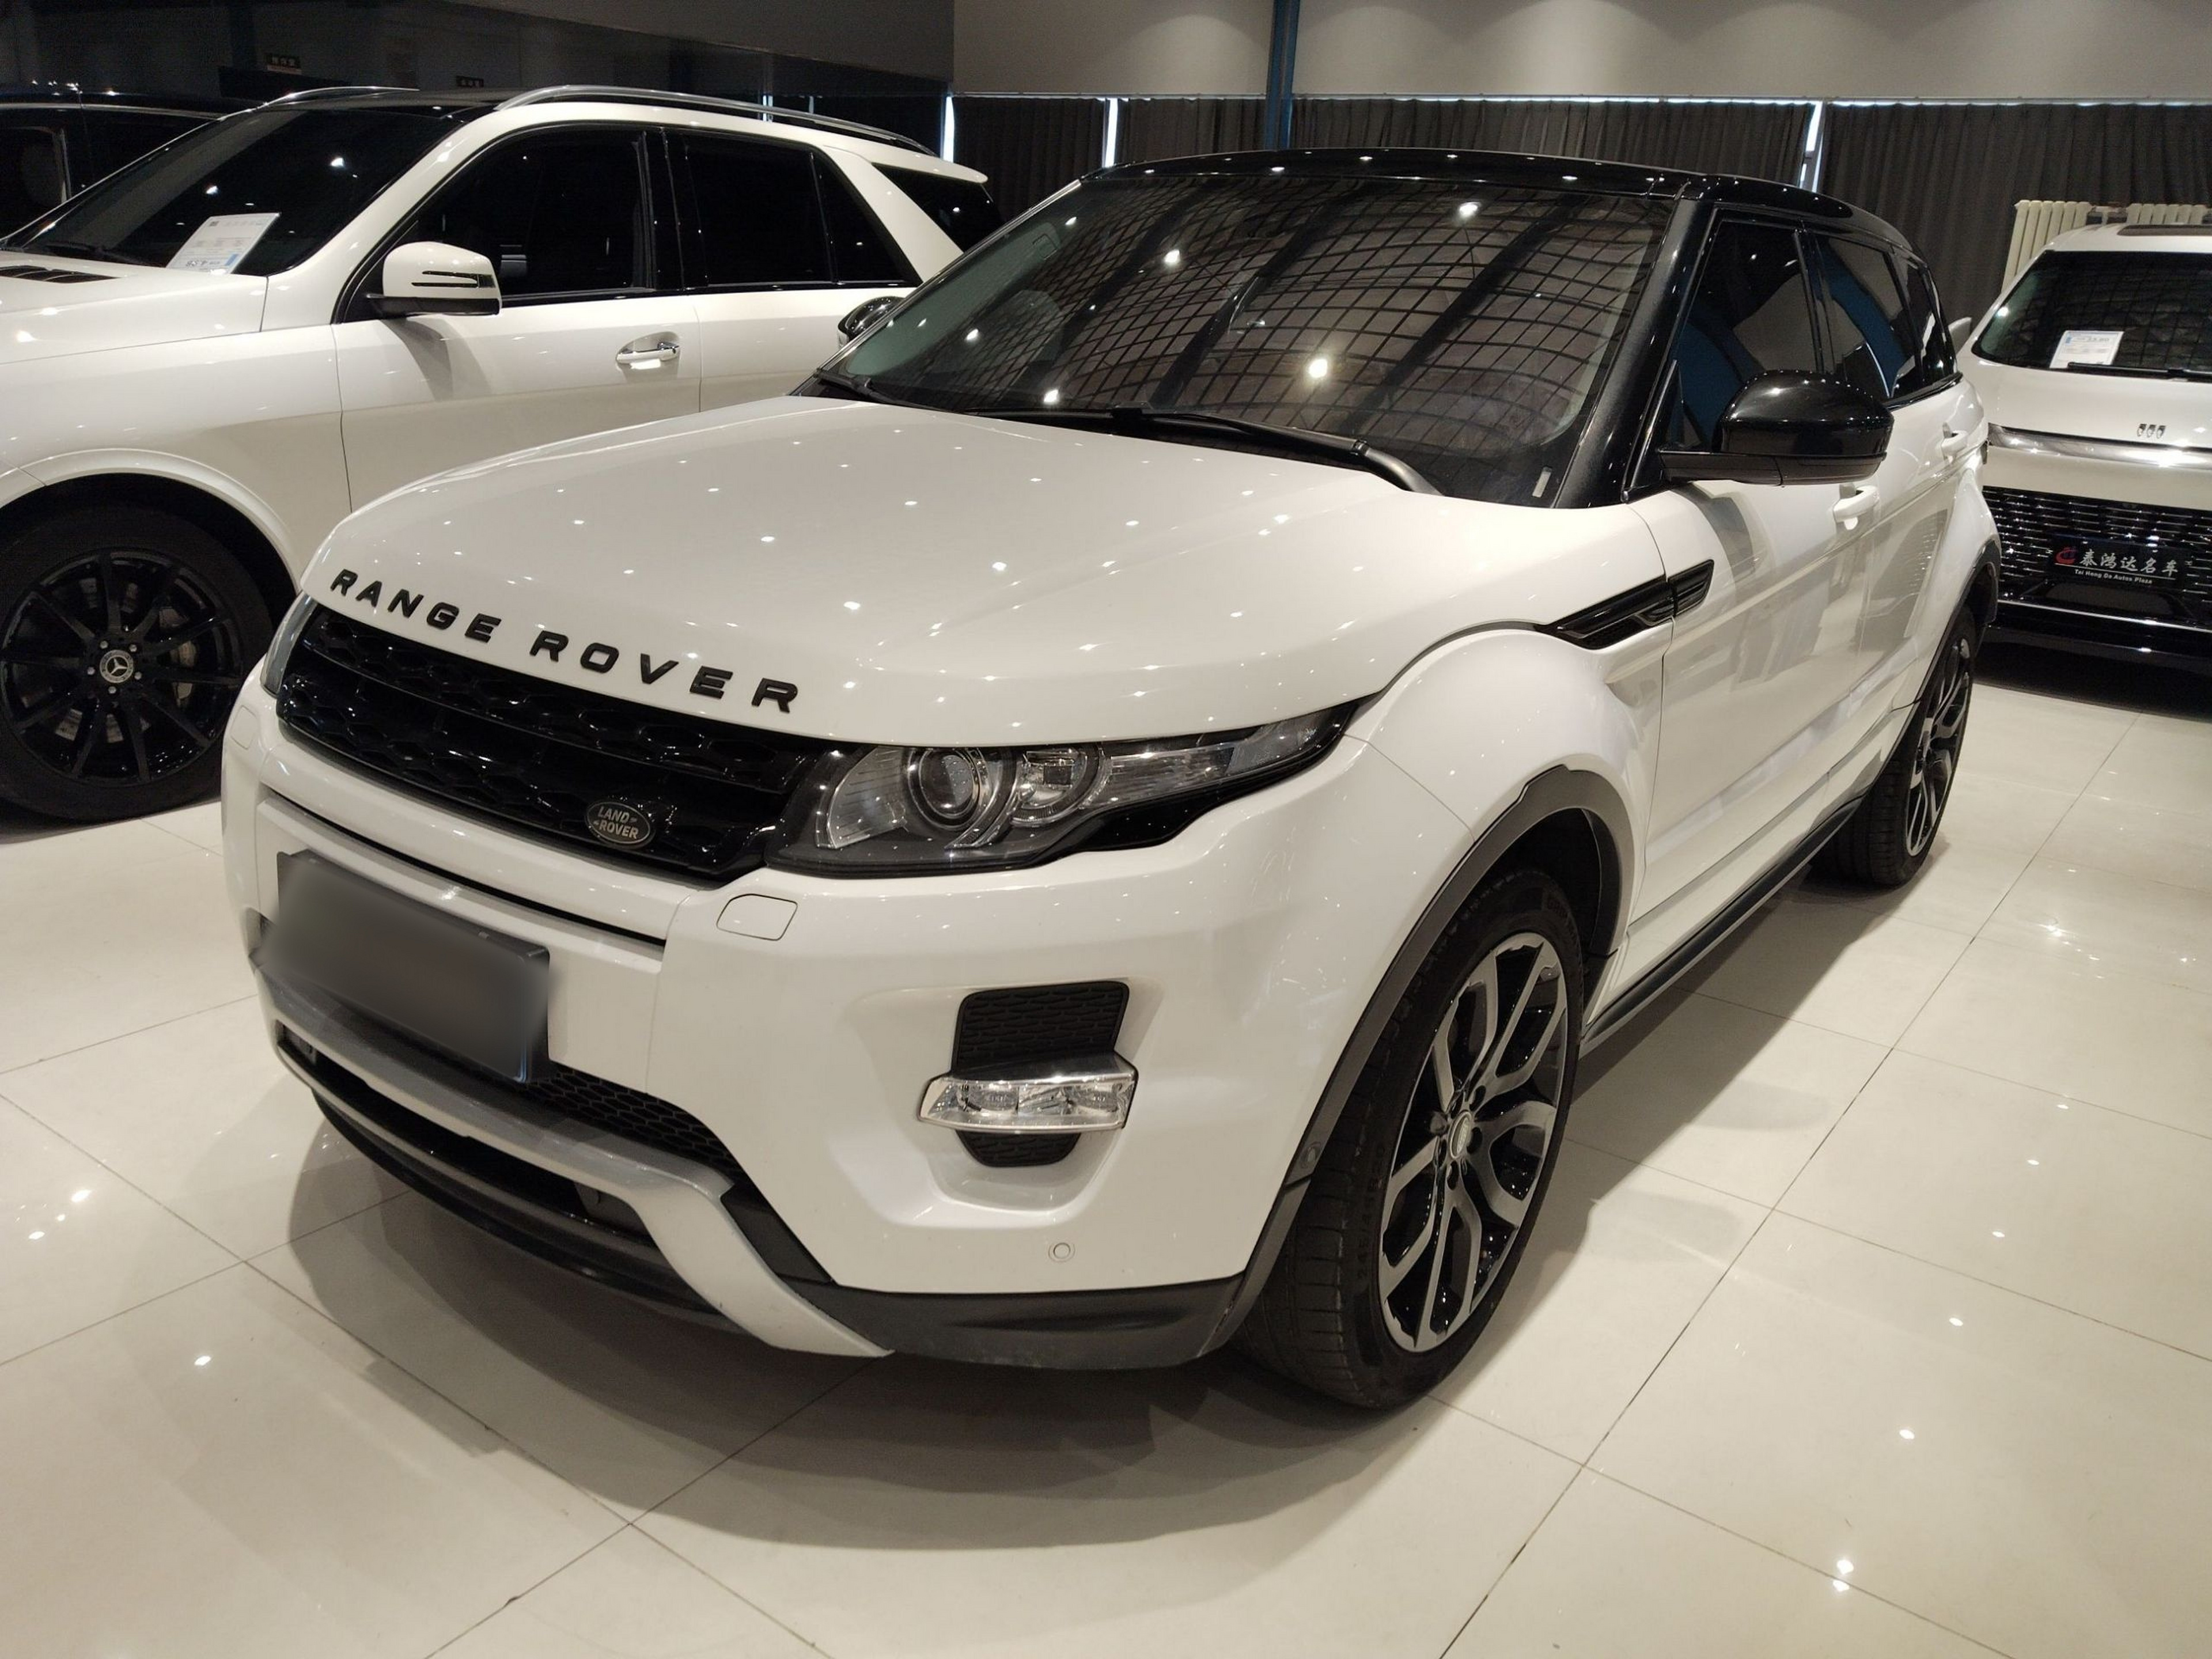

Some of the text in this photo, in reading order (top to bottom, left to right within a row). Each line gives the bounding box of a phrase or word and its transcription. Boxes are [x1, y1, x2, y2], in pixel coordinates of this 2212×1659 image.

[2079, 548, 2179, 577] 泰鸿达名车
[2113, 574, 2133, 582] Autos
[2134, 576, 2153, 584] Plaza
[330, 569, 798, 714] RANGE ROVER
[598, 806, 630, 824] LAND
[599, 819, 639, 839] ROVER
